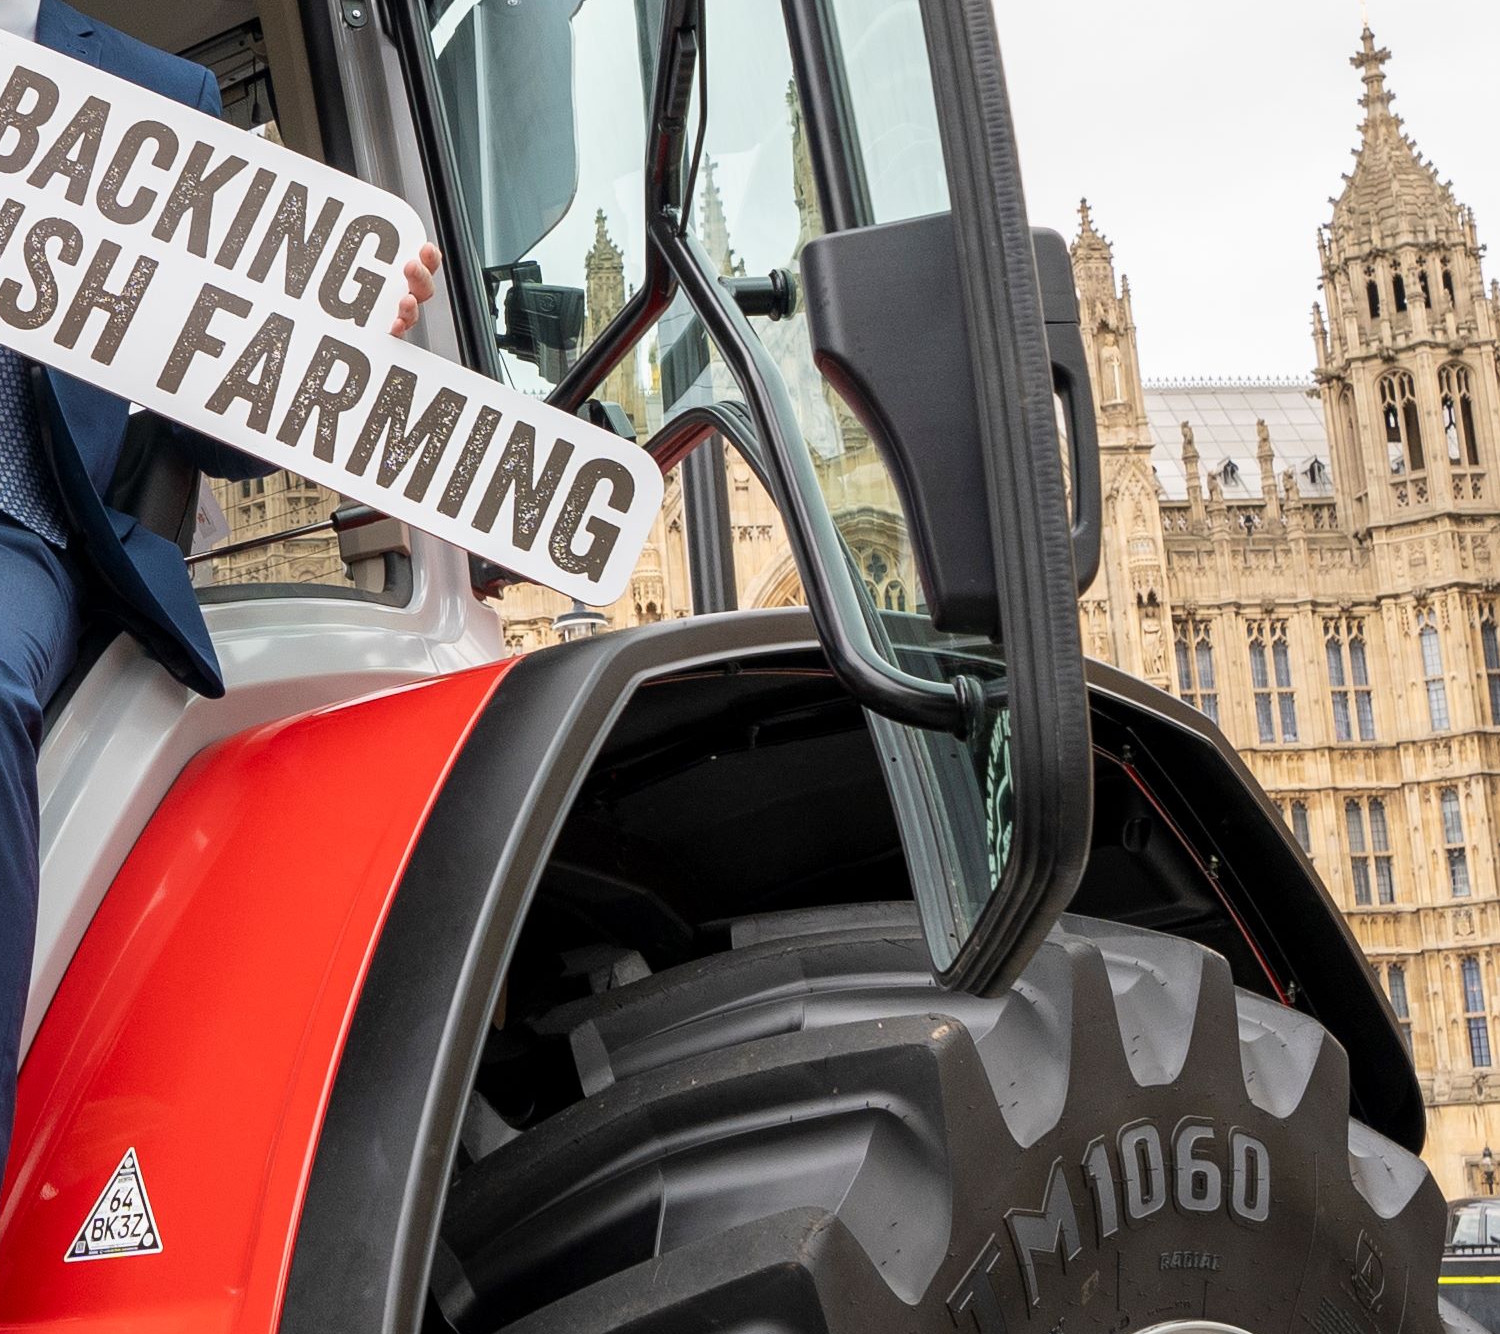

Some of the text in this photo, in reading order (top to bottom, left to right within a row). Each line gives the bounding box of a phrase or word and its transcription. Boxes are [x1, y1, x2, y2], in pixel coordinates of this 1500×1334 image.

[156, 283, 637, 582] FARMING
[110, 1187, 134, 1213] 64
[91, 1213, 144, 1242] BK3Z
